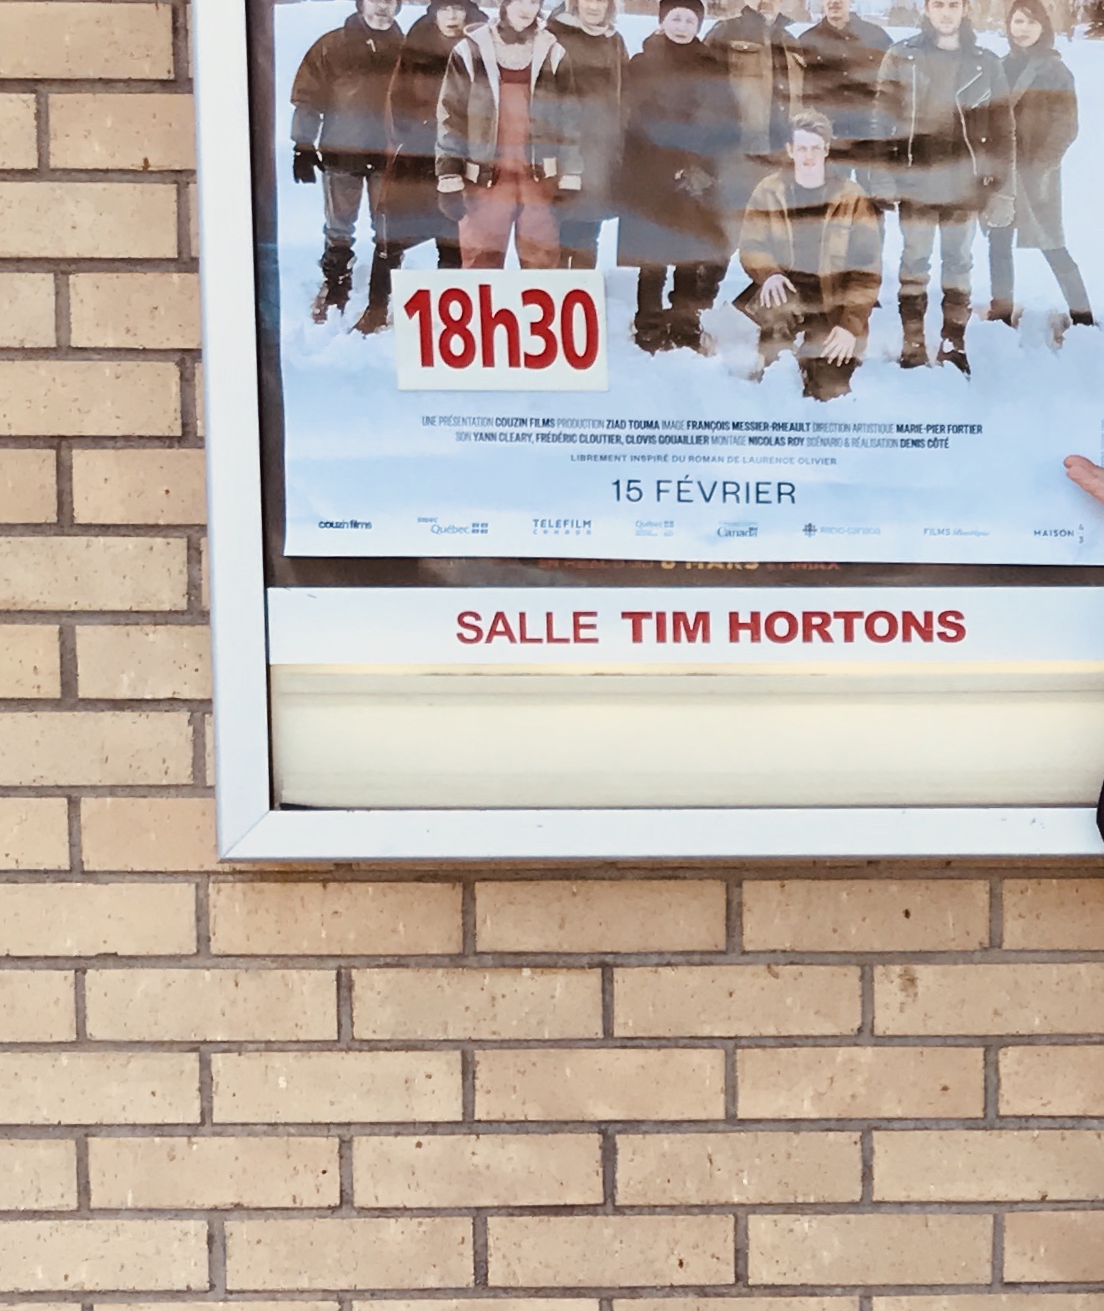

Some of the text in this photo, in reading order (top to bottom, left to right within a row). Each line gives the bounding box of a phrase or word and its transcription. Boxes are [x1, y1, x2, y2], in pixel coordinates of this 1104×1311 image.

[404, 284, 600, 371] 18h30
[421, 415, 983, 435] UNE PRÉSENTATION COUZIN FILMS PRODUCTION ZIAD TOUMA IMAGE FRANÇOIS MESSIER-RHEAULT DIRECTION ARTISTIQUE MARIE-PIER FORTIER
[473, 431, 497, 443] YANN
[499, 432, 534, 445] CLEARY,
[536, 430, 577, 444] FRÉDÉRIC
[579, 433, 625, 446] CLOUTIER,
[626, 434, 657, 445] CLOVIS
[711, 435, 747, 446] MONTAGE
[749, 436, 786, 447] NICOLAS
[788, 436, 805, 447] ROY
[852, 436, 898, 449] RÉALISATION
[900, 438, 926, 449] DENIS
[927, 437, 950, 449] CÔTÉ
[571, 453, 837, 466] LIBREMENT INSPIRÉ DU ROMAN DE LAURENCE OLIVIER
[612, 474, 796, 504] 15 FÉVRIER
[532, 519, 592, 529] TELEFILM
[1033, 529, 1074, 538] MAISON
[456, 610, 967, 645] SALLE TIM HORTONS
